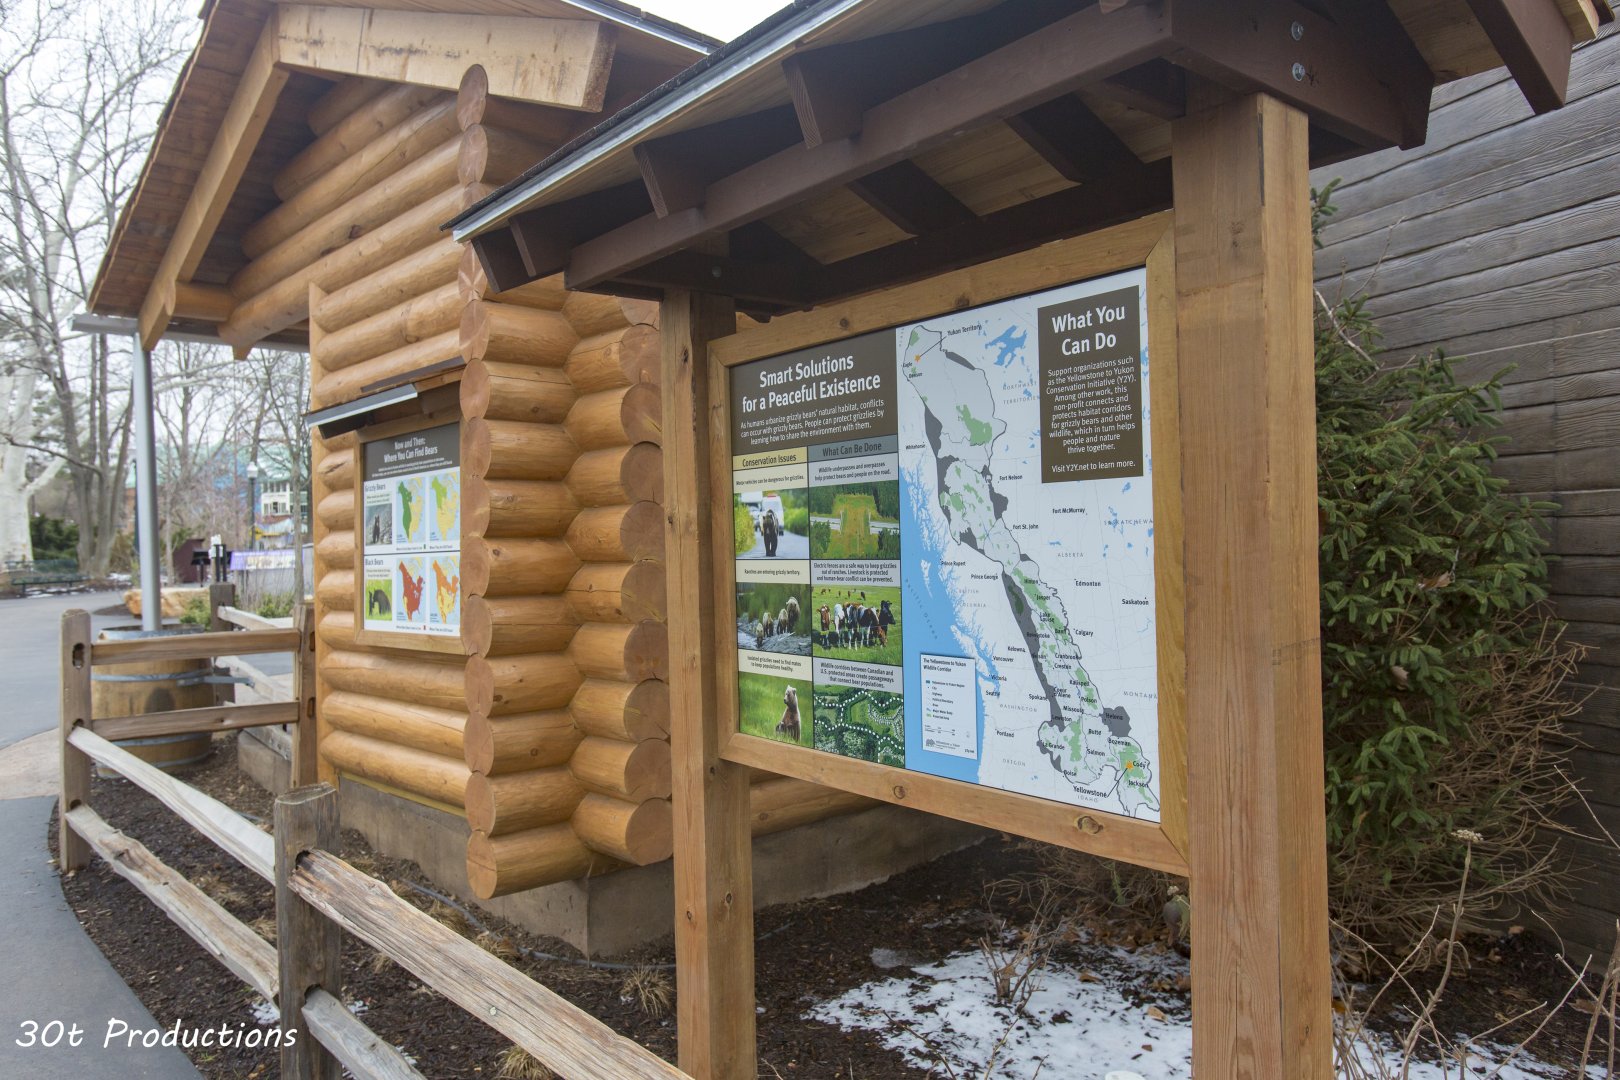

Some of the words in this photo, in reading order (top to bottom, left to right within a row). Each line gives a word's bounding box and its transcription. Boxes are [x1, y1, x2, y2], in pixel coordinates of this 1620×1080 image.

[1052, 311, 1092, 333] What
[1095, 306, 1124, 324] You
[948, 328, 962, 336] Yukon
[962, 324, 982, 334] Territory
[1061, 338, 1089, 356] Can
[1095, 331, 1116, 350] Do
[759, 367, 792, 387] Smart
[795, 355, 853, 380] Solutions
[1047, 367, 1071, 376] Support
[1073, 360, 1116, 372] organizations
[1118, 355, 1133, 364] such
[1066, 372, 1104, 382] Yellowstone
[1113, 366, 1134, 375] Yukon
[1046, 383, 1085, 394] Conservation
[1087, 378, 1115, 388] Initiative
[1116, 374, 1136, 384] (Y2Y).
[1095, 387, 1112, 396] work,
[742, 396, 757, 412] for
[759, 396, 765, 409] a
[768, 382, 816, 407] Peaceful
[819, 374, 880, 398] Existence
[1054, 400, 1083, 410] non-profit
[1085, 397, 1114, 406] connects
[1116, 394, 1128, 402] and
[765, 416, 785, 424] urbanize
[786, 413, 801, 422] grizzly
[818, 406, 836, 415] natural
[838, 404, 858, 412] habitat,
[860, 399, 884, 408] conflicts
[1052, 412, 1076, 421] protects
[1078, 408, 1100, 416] habitat
[1102, 404, 1130, 413] corridors
[773, 424, 787, 433] grizzly
[804, 419, 821, 427] People
[833, 414, 851, 424] protect
[853, 411, 874, 421] grizzlies
[876, 409, 884, 417] by
[1060, 419, 1080, 428] grizzly
[809, 426, 841, 436] environment
[842, 423, 854, 431] with
[1048, 429, 1072, 437] wildlife,
[1074, 426, 1092, 435] which
[1116, 422, 1135, 430] helps
[394, 441, 403, 449] Now
[1062, 436, 1084, 446] people
[1086, 443, 1115, 452] together.
[384, 453, 396, 462] Where
[414, 446, 423, 457] Find
[425, 446, 437, 455] Bears
[822, 447, 838, 456] What
[840, 445, 852, 454] Can
[854, 444, 861, 453] Be
[864, 442, 881, 451] Done
[742, 456, 776, 467] Conservation
[778, 454, 796, 462] Issues
[1133, 761, 1146, 769] Cody
[1073, 786, 1107, 798] Yellowstone
